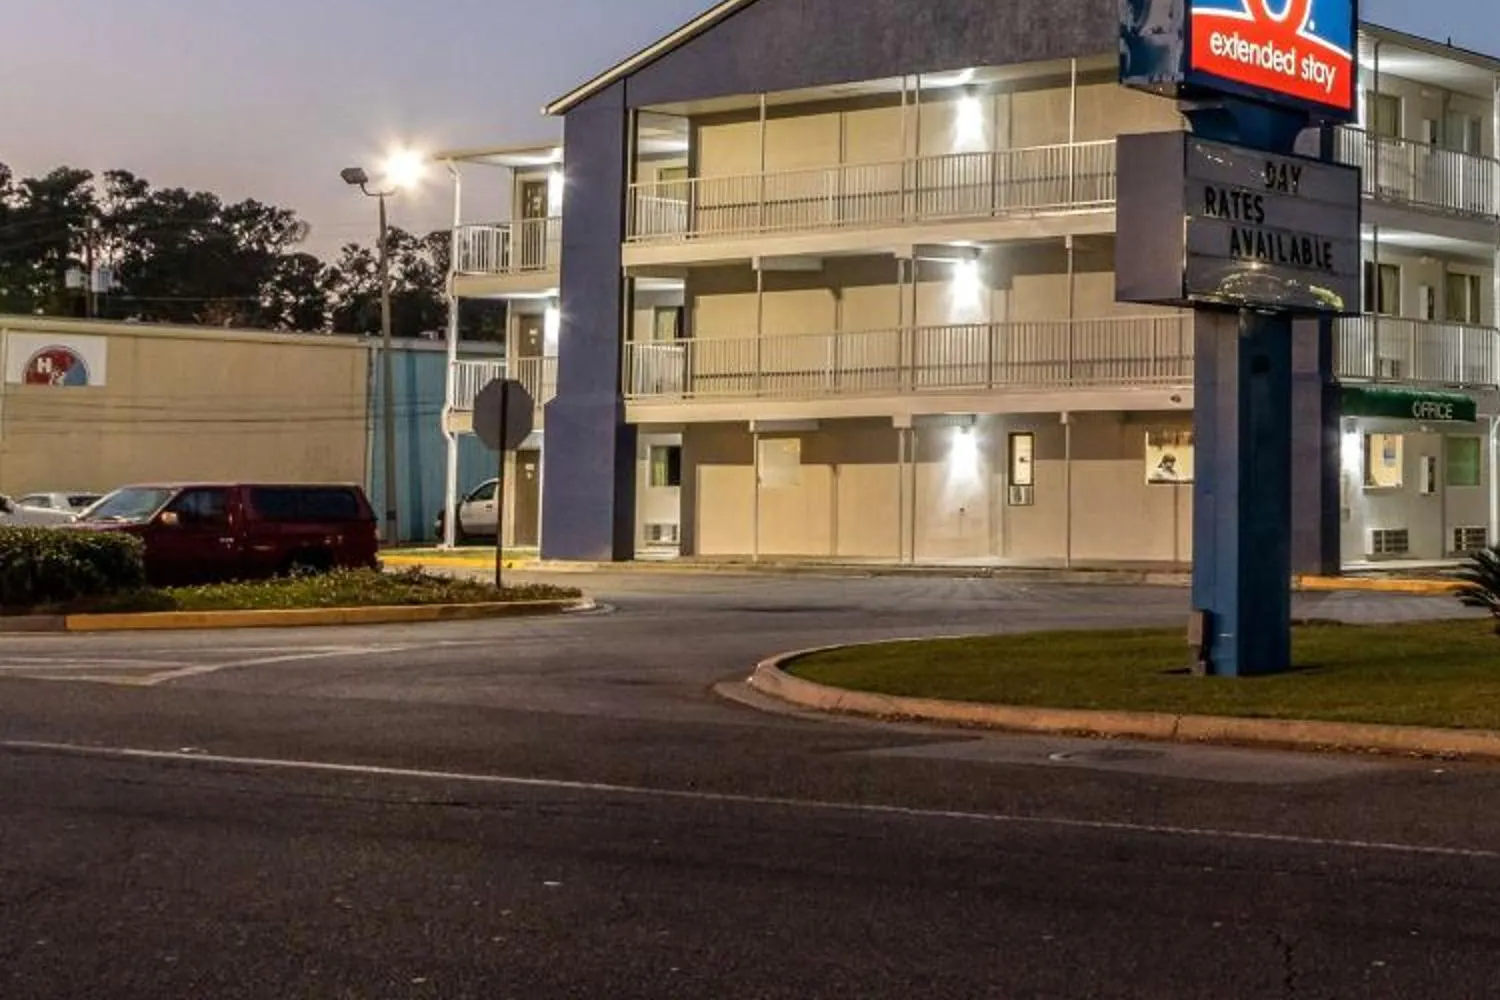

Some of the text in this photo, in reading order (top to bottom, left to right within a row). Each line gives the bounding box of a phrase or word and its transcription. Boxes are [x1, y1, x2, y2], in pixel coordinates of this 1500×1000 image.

[1209, 30, 1336, 95] extended stay
[1264, 161, 1302, 193] DAY
[1204, 185, 1265, 224] RATES
[1230, 226, 1333, 270] AVAILABLE
[1411, 401, 1454, 420] OFFICE
